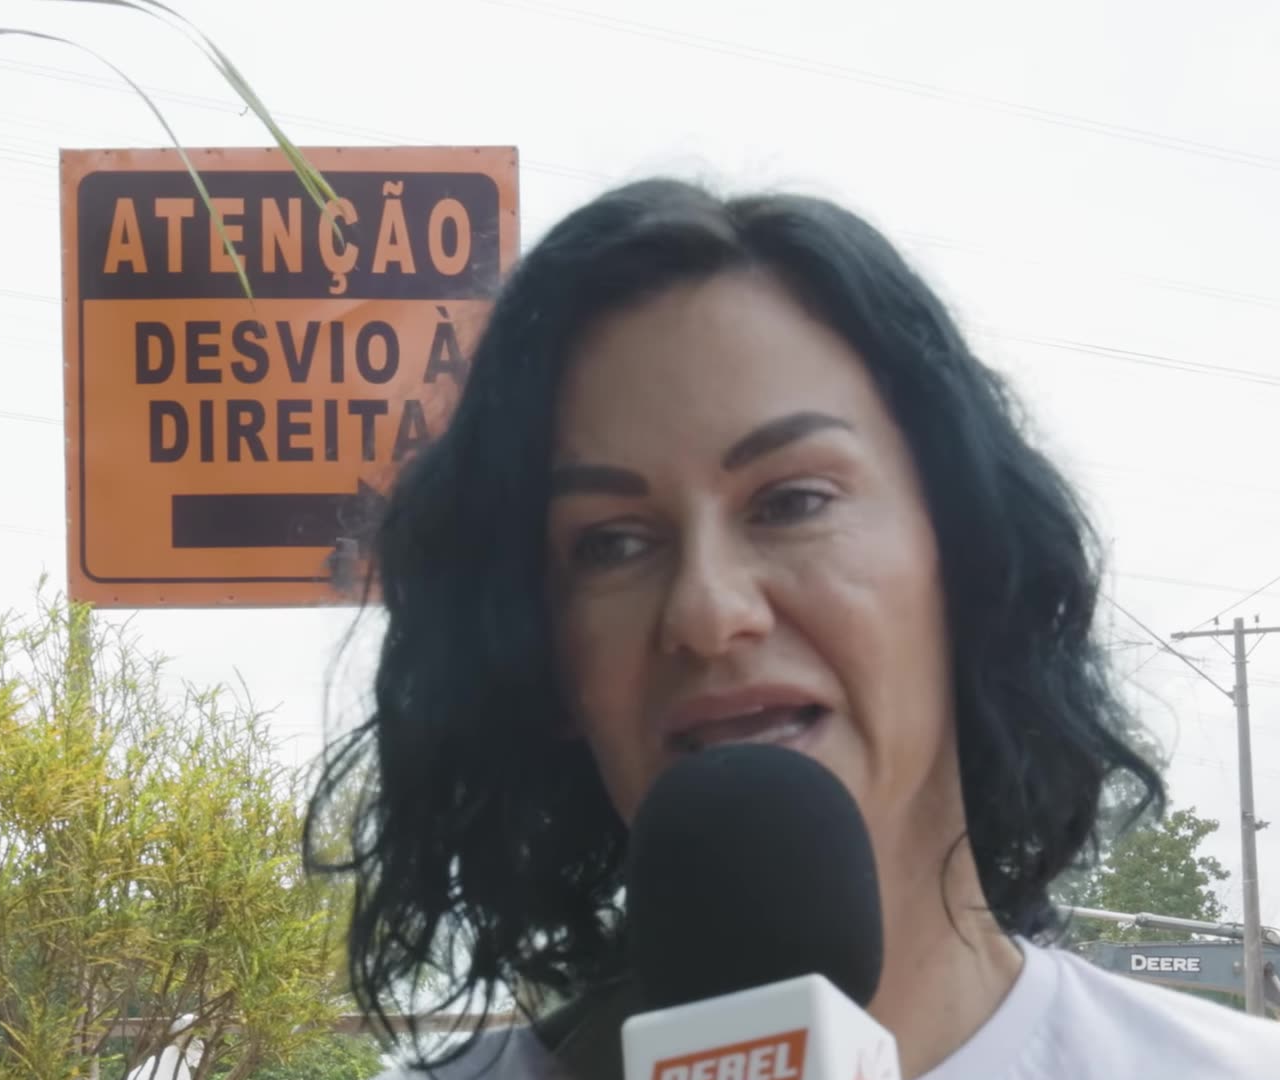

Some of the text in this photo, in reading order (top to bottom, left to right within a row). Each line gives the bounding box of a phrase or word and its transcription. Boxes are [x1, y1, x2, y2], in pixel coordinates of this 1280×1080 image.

[102, 180, 472, 295] ATENÇÃO
[134, 306, 470, 385] DESVIO À
[148, 398, 432, 463] DIREITA
[1130, 954, 1201, 972] DEERE
